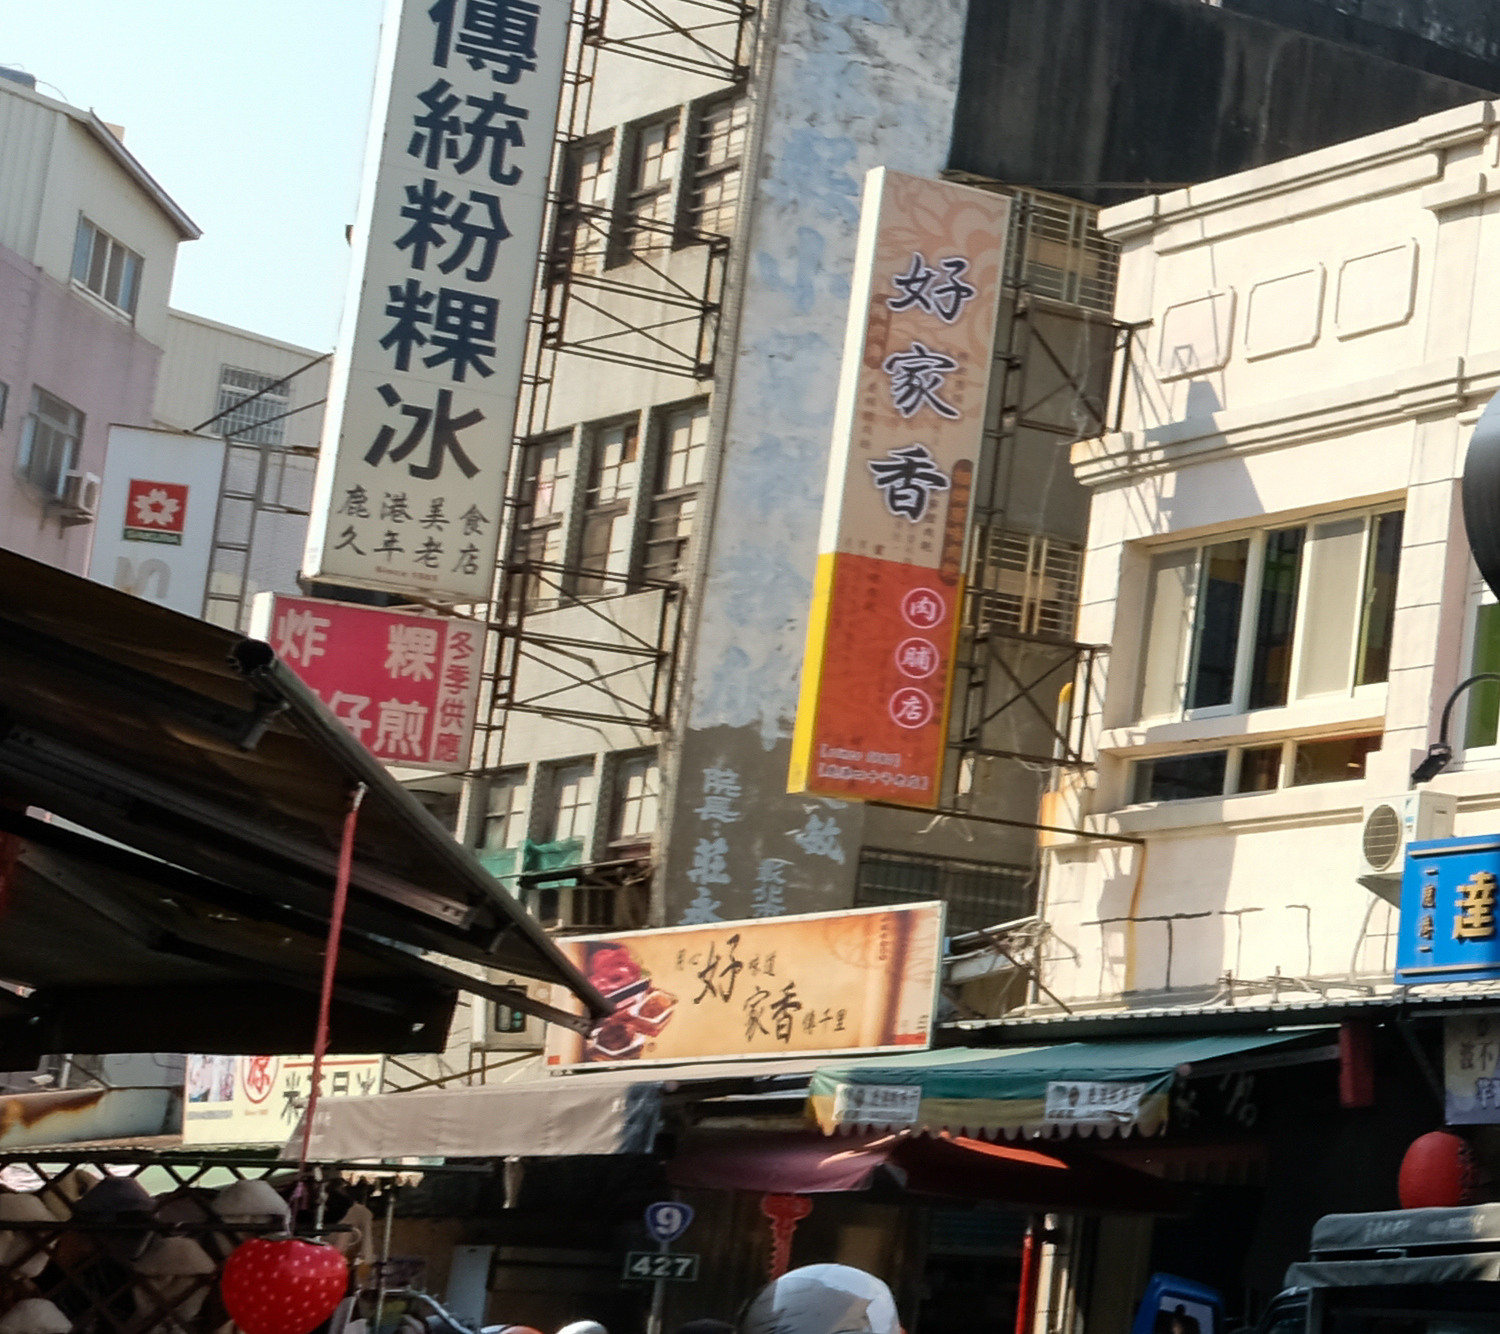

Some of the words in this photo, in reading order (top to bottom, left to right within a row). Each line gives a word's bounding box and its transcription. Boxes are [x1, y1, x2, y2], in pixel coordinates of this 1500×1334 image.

[866, 251, 977, 523] 好家香
[337, 483, 490, 536] 鹿港美食
[333, 523, 482, 576] 久年老店
[278, 607, 440, 682] 炸粿
[312, 687, 429, 758] 仔煎
[655, 1207, 682, 1236] 9
[631, 1255, 694, 1278] 427
